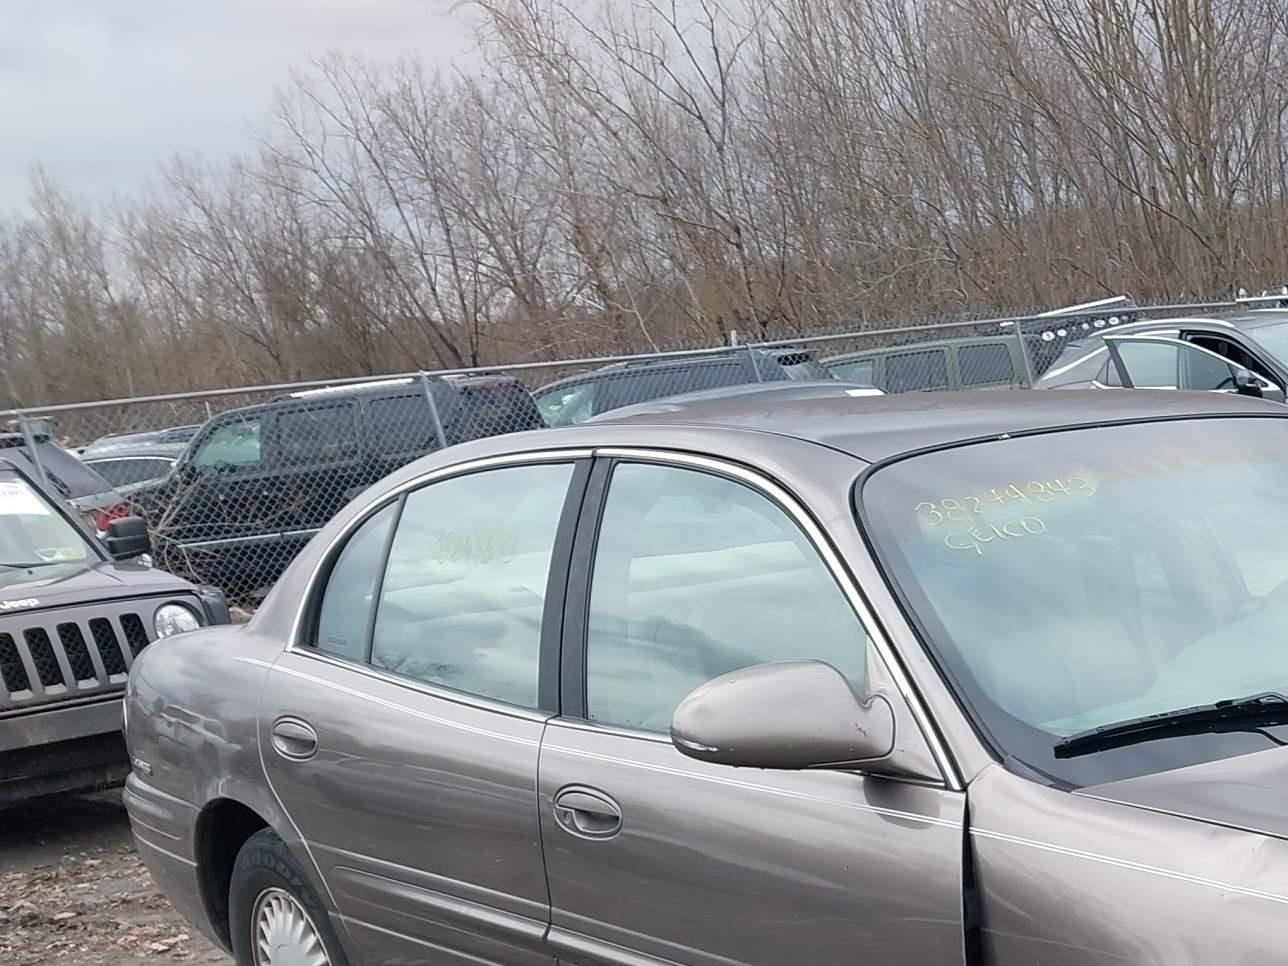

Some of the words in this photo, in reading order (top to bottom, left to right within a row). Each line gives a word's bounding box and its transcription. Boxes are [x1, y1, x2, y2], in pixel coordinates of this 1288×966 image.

[914, 475, 1097, 526] 38244843
[944, 516, 1046, 556] GEICO
[0, 598, 40, 610] Jeep
